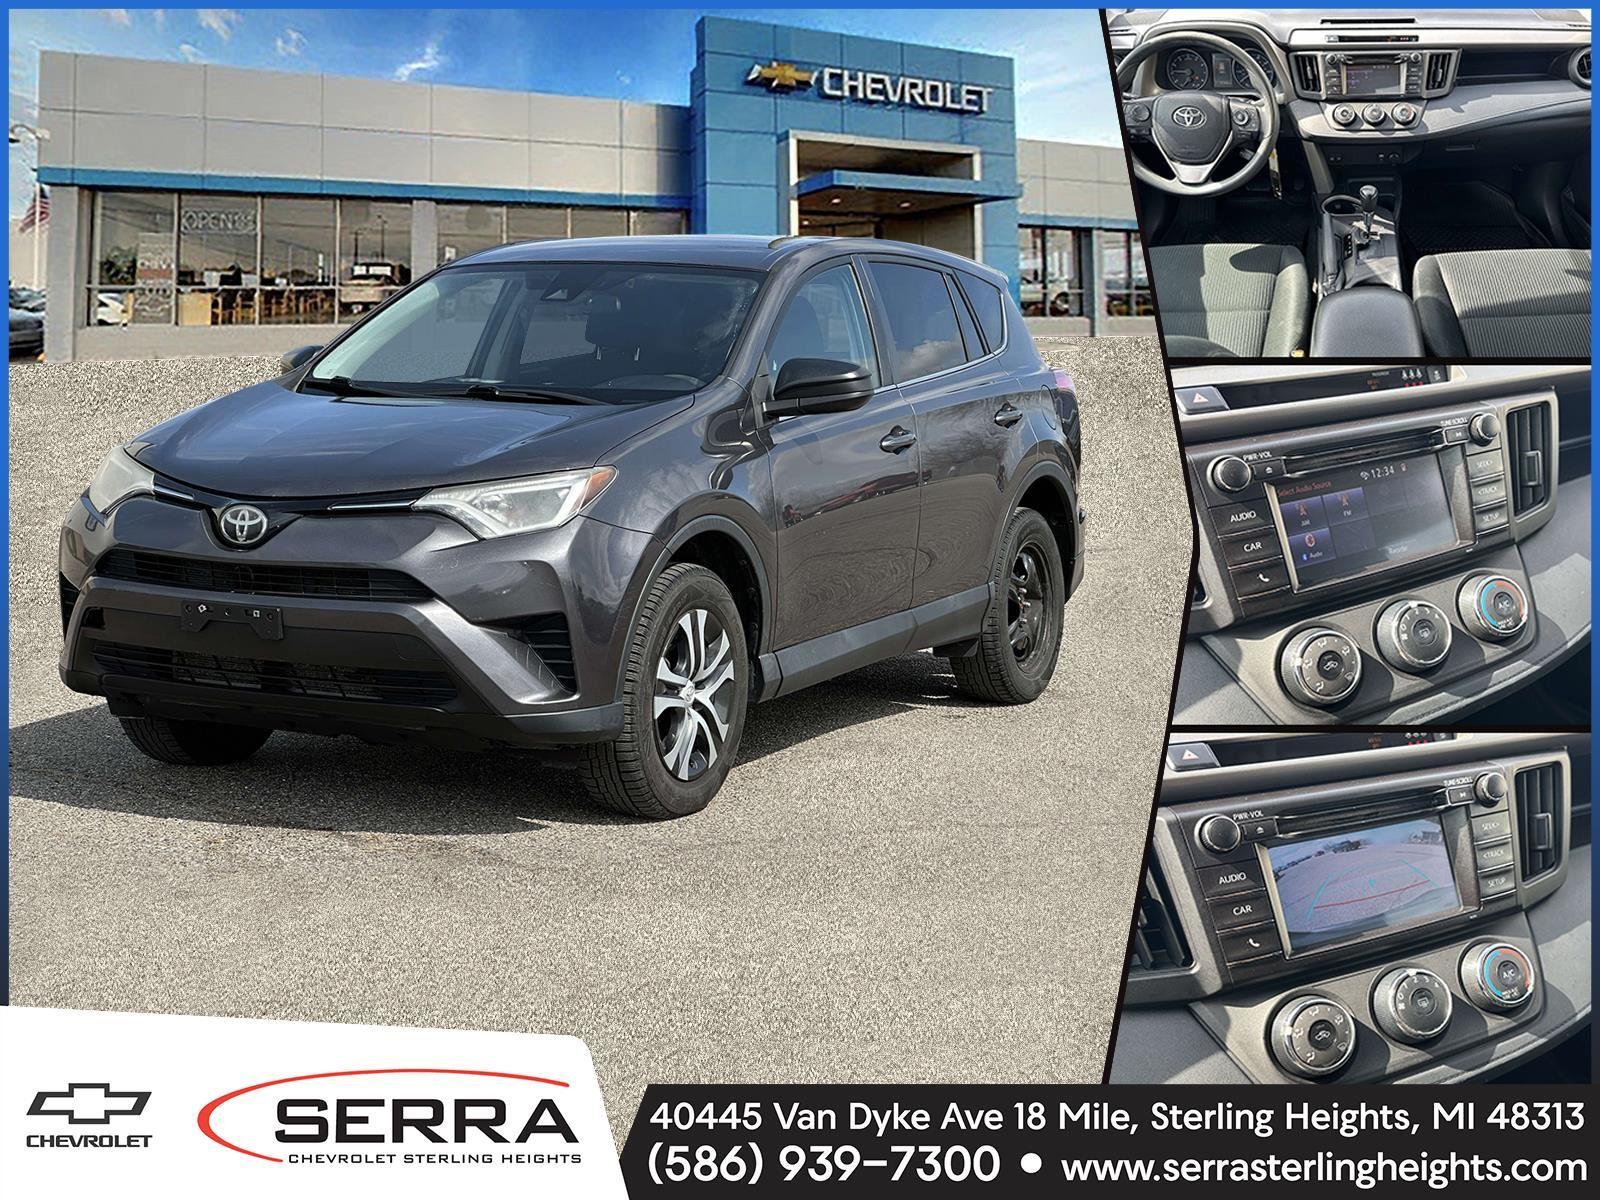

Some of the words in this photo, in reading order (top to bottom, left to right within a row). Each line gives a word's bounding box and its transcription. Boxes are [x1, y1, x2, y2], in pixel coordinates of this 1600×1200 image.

[823, 67, 994, 112] CHEVROLET
[1370, 465, 1395, 479] 12:34
[1230, 511, 1257, 523] AUDIO
[1243, 541, 1262, 552] CAR
[1219, 872, 1247, 885] AUDIO
[1488, 877, 1506, 888] SETUP
[1232, 904, 1252, 916] CAR
[1503, 969, 1515, 979] A/C
